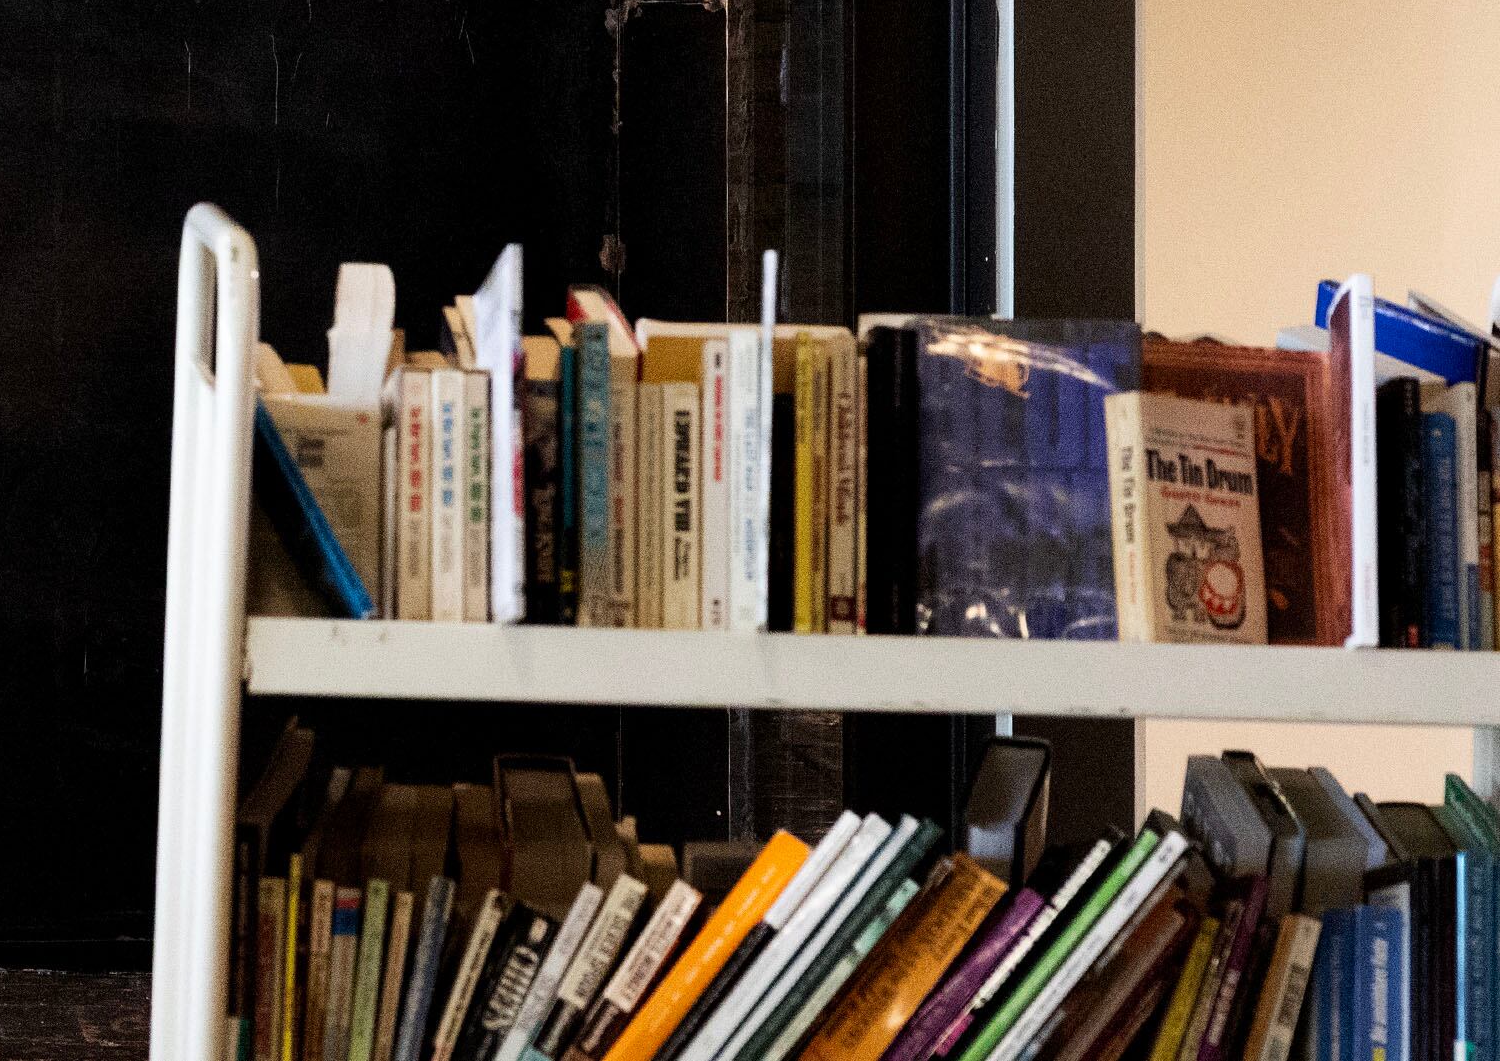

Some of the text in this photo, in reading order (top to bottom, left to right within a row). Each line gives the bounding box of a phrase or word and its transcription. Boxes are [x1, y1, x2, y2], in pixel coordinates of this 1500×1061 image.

[1145, 448, 1254, 496] The Tin Drum
